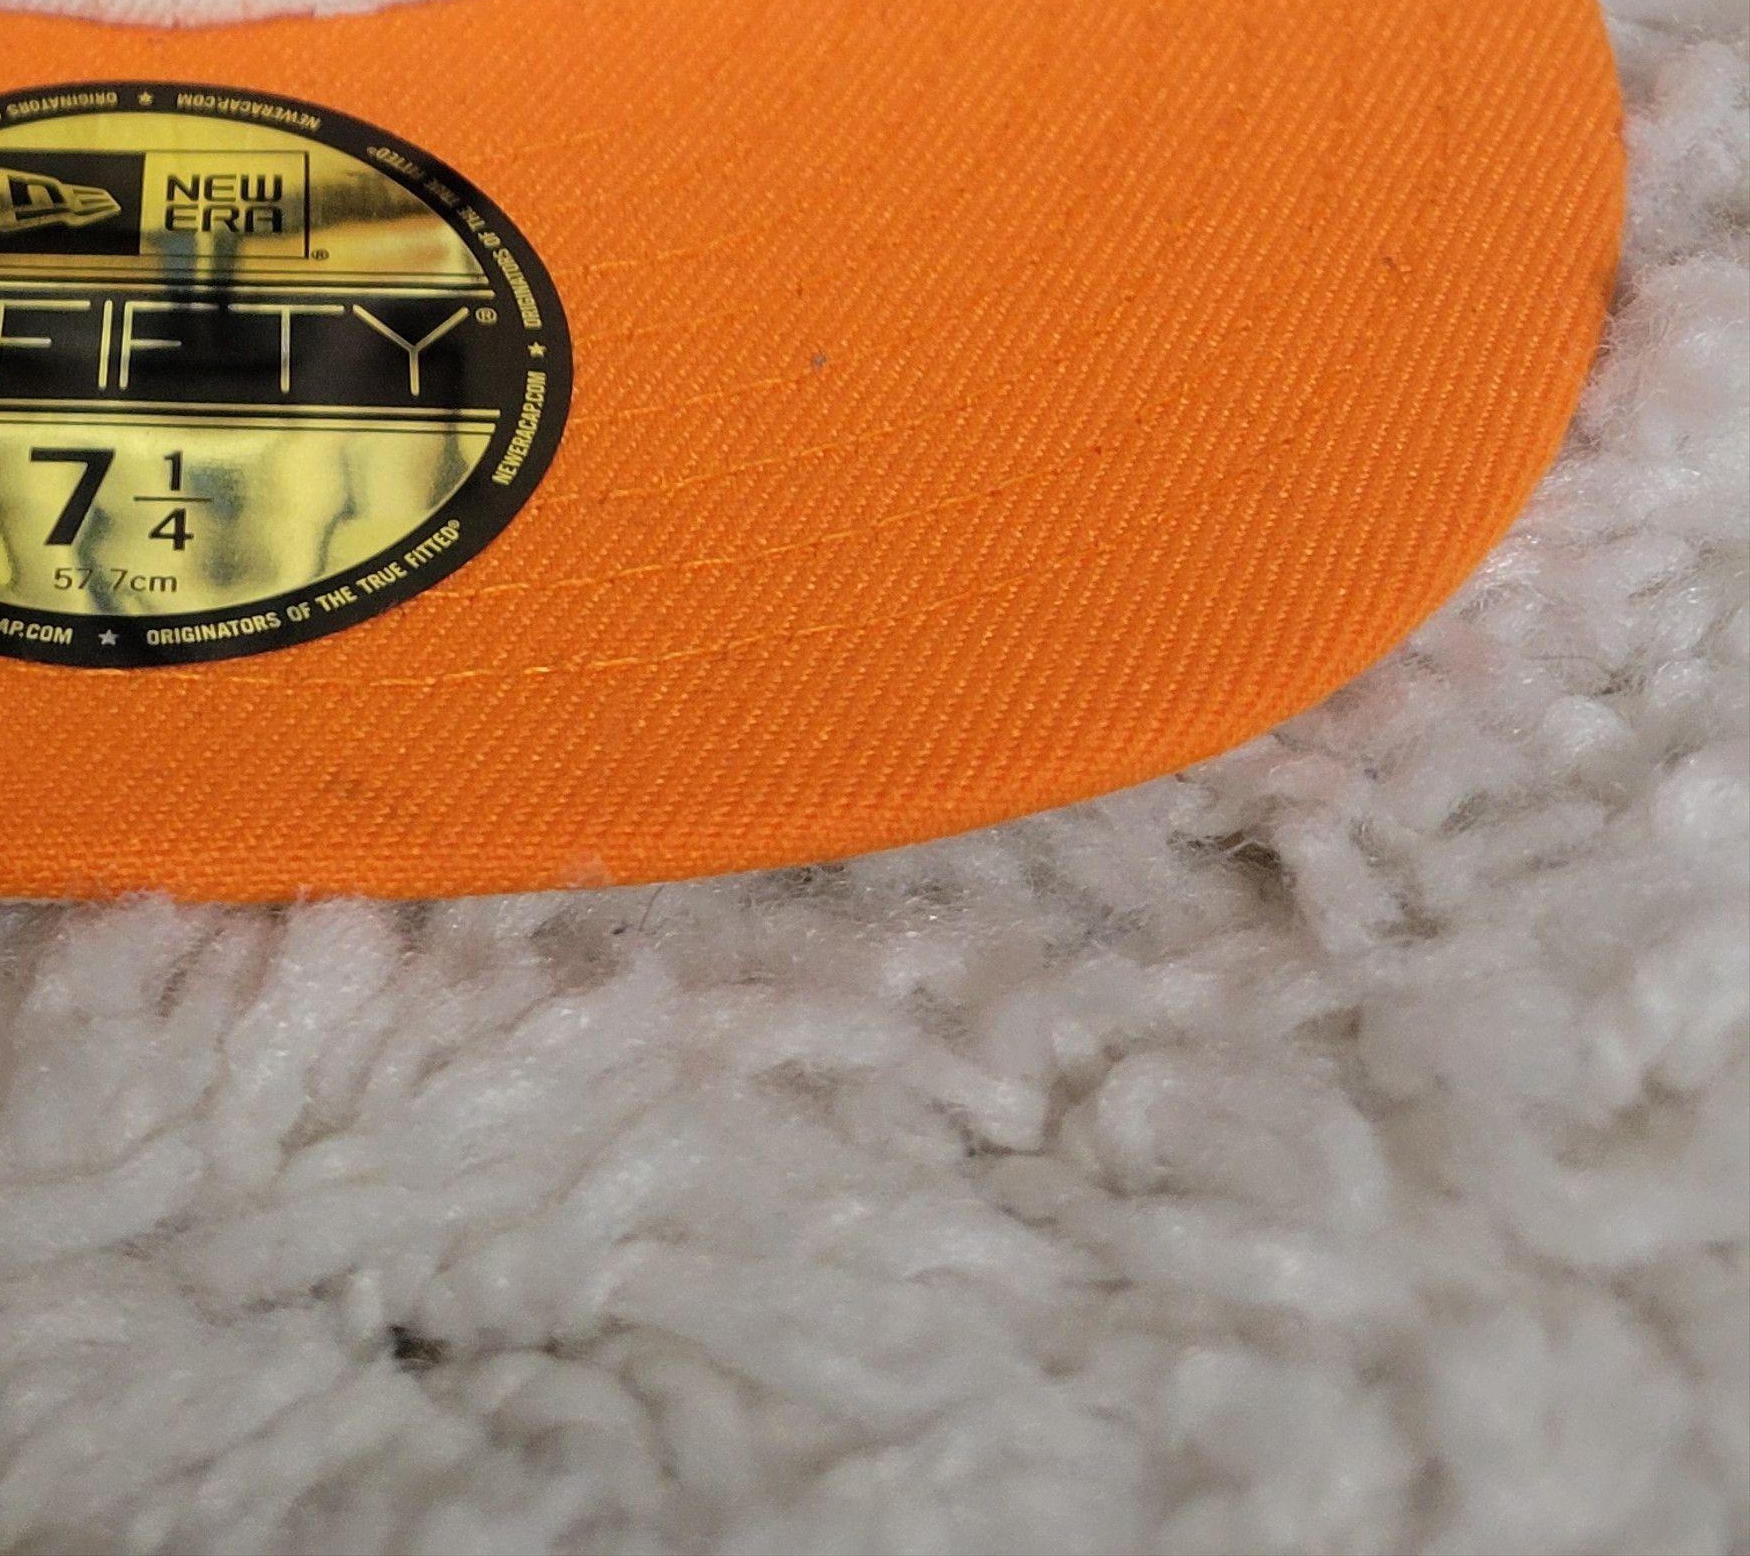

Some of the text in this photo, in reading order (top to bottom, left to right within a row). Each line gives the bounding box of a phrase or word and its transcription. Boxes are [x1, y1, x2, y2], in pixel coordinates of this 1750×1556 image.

[6, 91, 118, 118] ORIGINATORS
[176, 92, 323, 133] NEWERACAP.COM
[165, 173, 284, 204] NEW
[164, 204, 284, 234] ERA
[491, 370, 547, 486] NEWERACAP.COM
[29, 446, 117, 547] 7
[53, 567, 178, 593] 577cm
[145, 610, 282, 647] ORIGINATORS
[285, 601, 312, 623] OF
[314, 585, 359, 613] THE
[355, 561, 408, 594] TRUE
